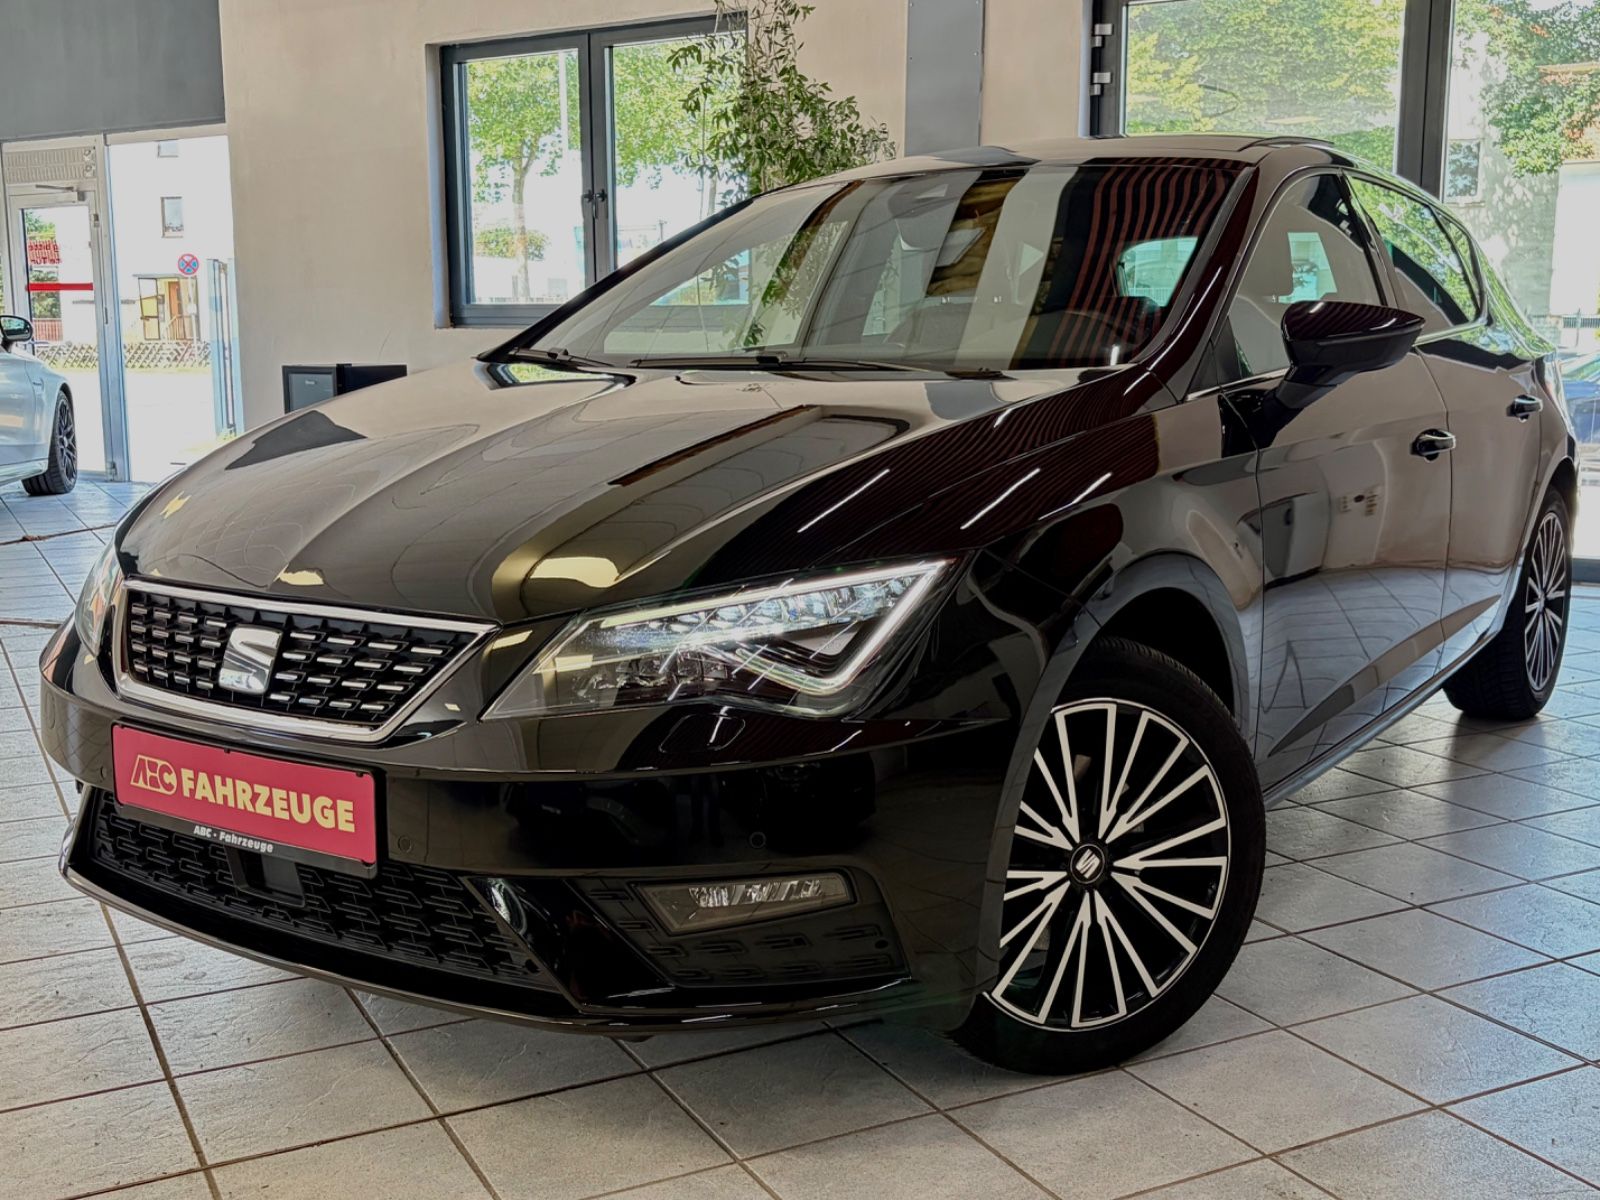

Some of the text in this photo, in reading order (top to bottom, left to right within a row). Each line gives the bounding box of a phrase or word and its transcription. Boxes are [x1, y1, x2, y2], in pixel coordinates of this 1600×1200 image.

[181, 768, 355, 832] FAHRZEUGE
[193, 825, 213, 838] ABC
[219, 831, 274, 853] Fahrzeuge
